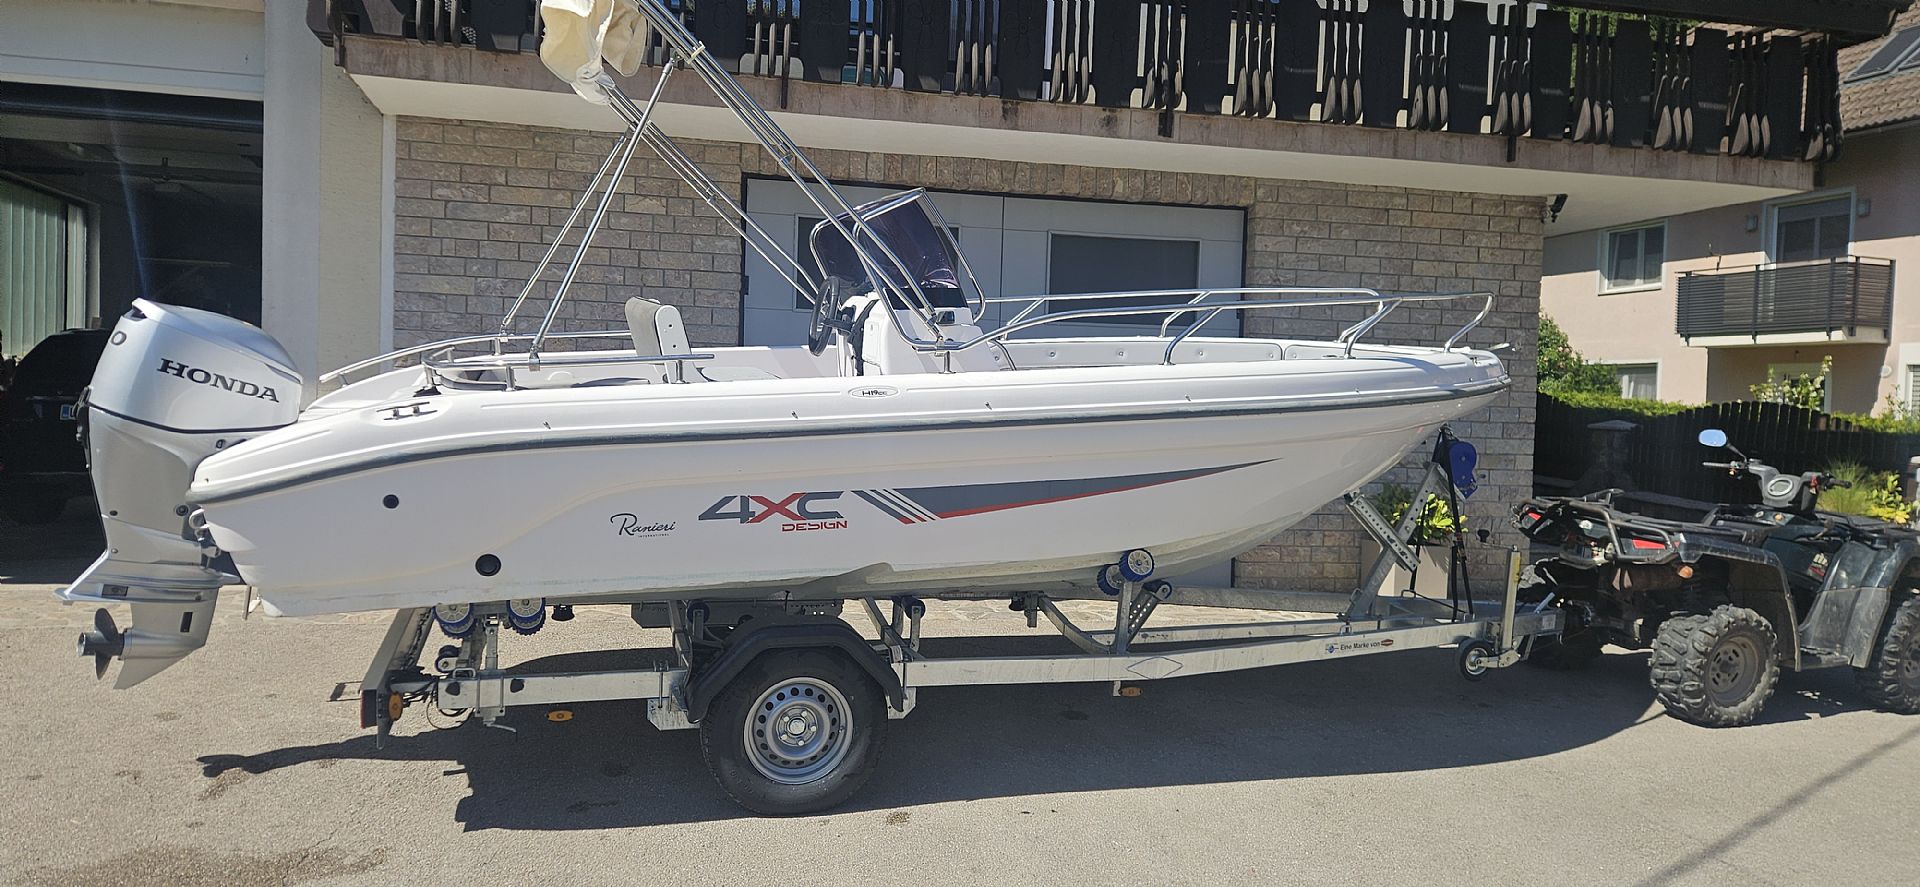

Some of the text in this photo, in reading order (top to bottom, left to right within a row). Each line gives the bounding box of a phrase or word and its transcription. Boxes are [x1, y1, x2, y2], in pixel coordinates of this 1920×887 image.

[156, 358, 280, 403] HONDA
[698, 490, 845, 524] 4XC
[610, 512, 676, 536] Ranieri
[781, 520, 848, 532] DESIGN
